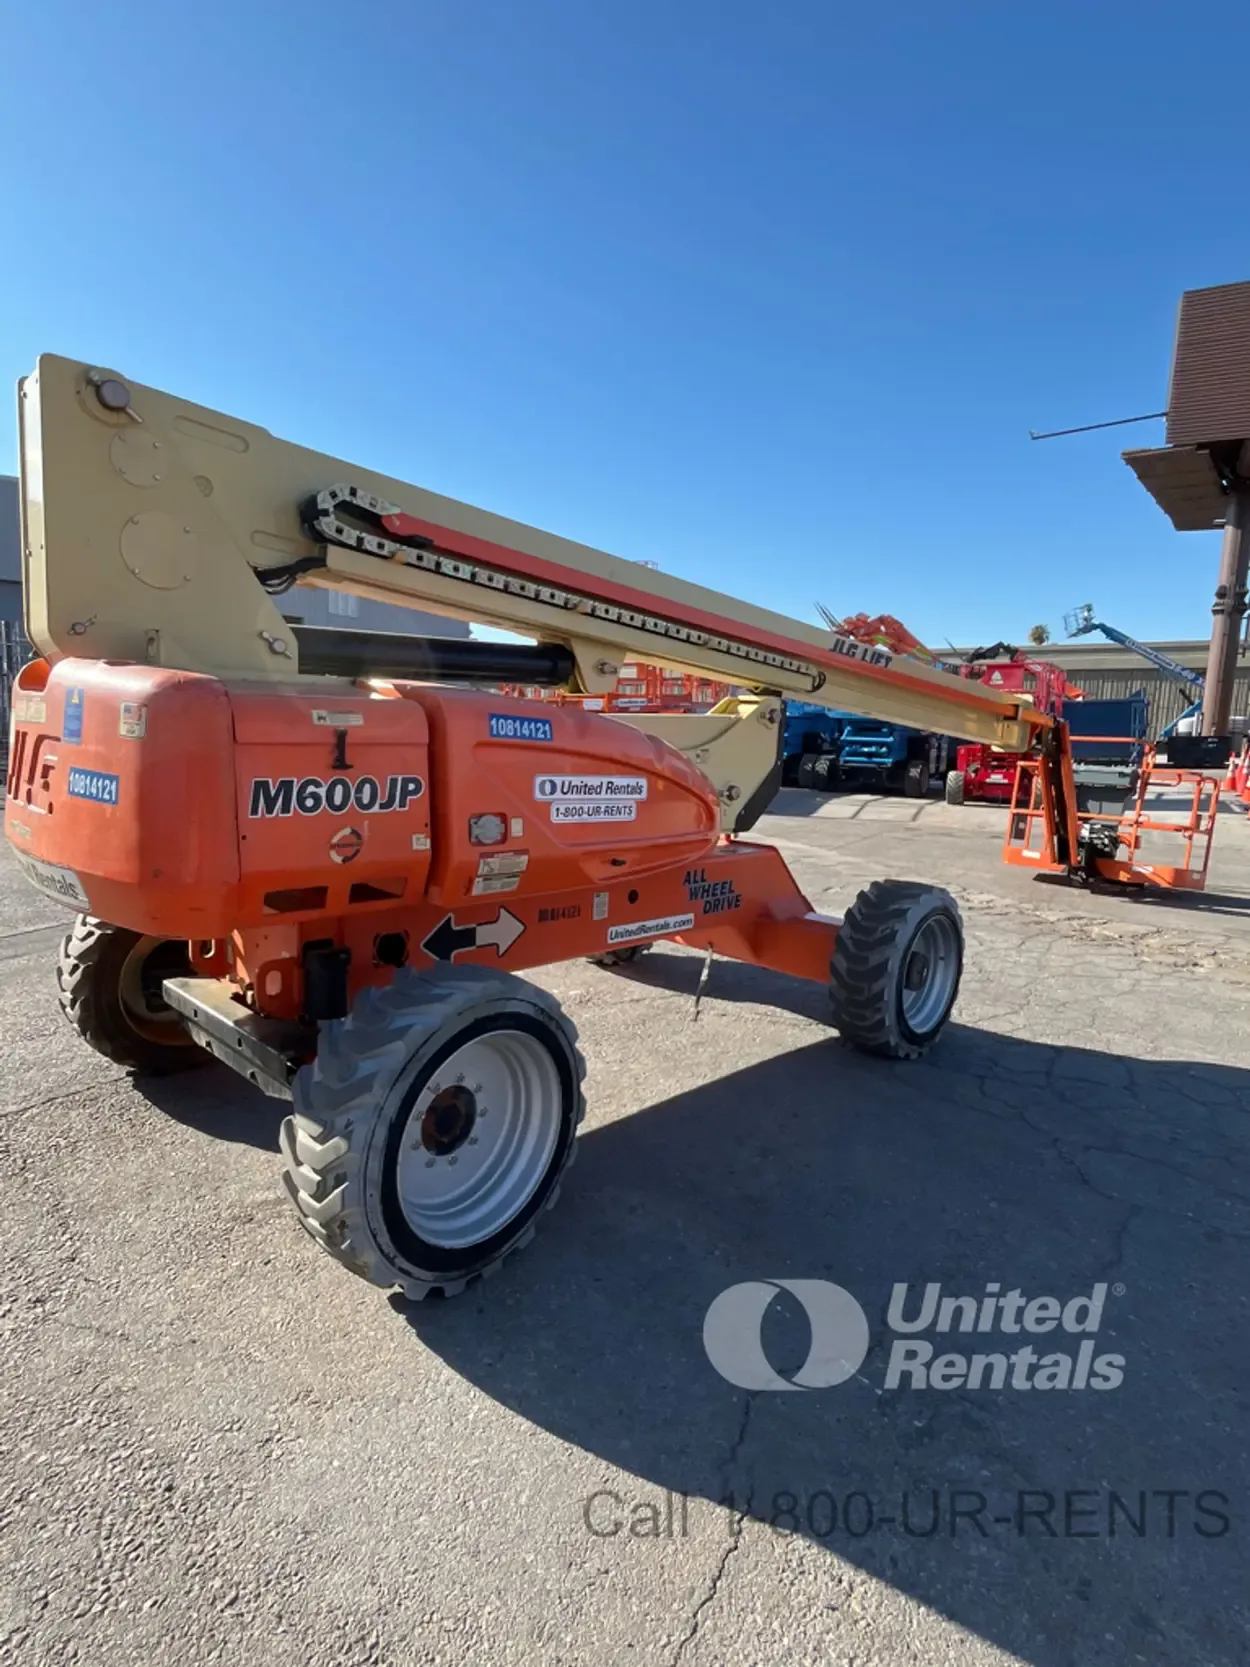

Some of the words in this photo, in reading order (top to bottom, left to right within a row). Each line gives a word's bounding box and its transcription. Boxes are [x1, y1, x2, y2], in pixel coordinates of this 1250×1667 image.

[829, 638, 858, 658] JLG
[860, 647, 893, 668] LIFT
[491, 717, 552, 739] 10814121
[68, 771, 117, 801] 10814121
[249, 775, 425, 818] M600JP
[560, 780, 604, 796] United
[605, 780, 644, 796] Rentals
[554, 804, 634, 819] 1-800-UR-RENTS
[683, 868, 707, 885] ALL
[689, 880, 735, 901] WHEEL
[703, 894, 742, 915] DRIVE
[609, 918, 693, 941] UnitedRentals.com
